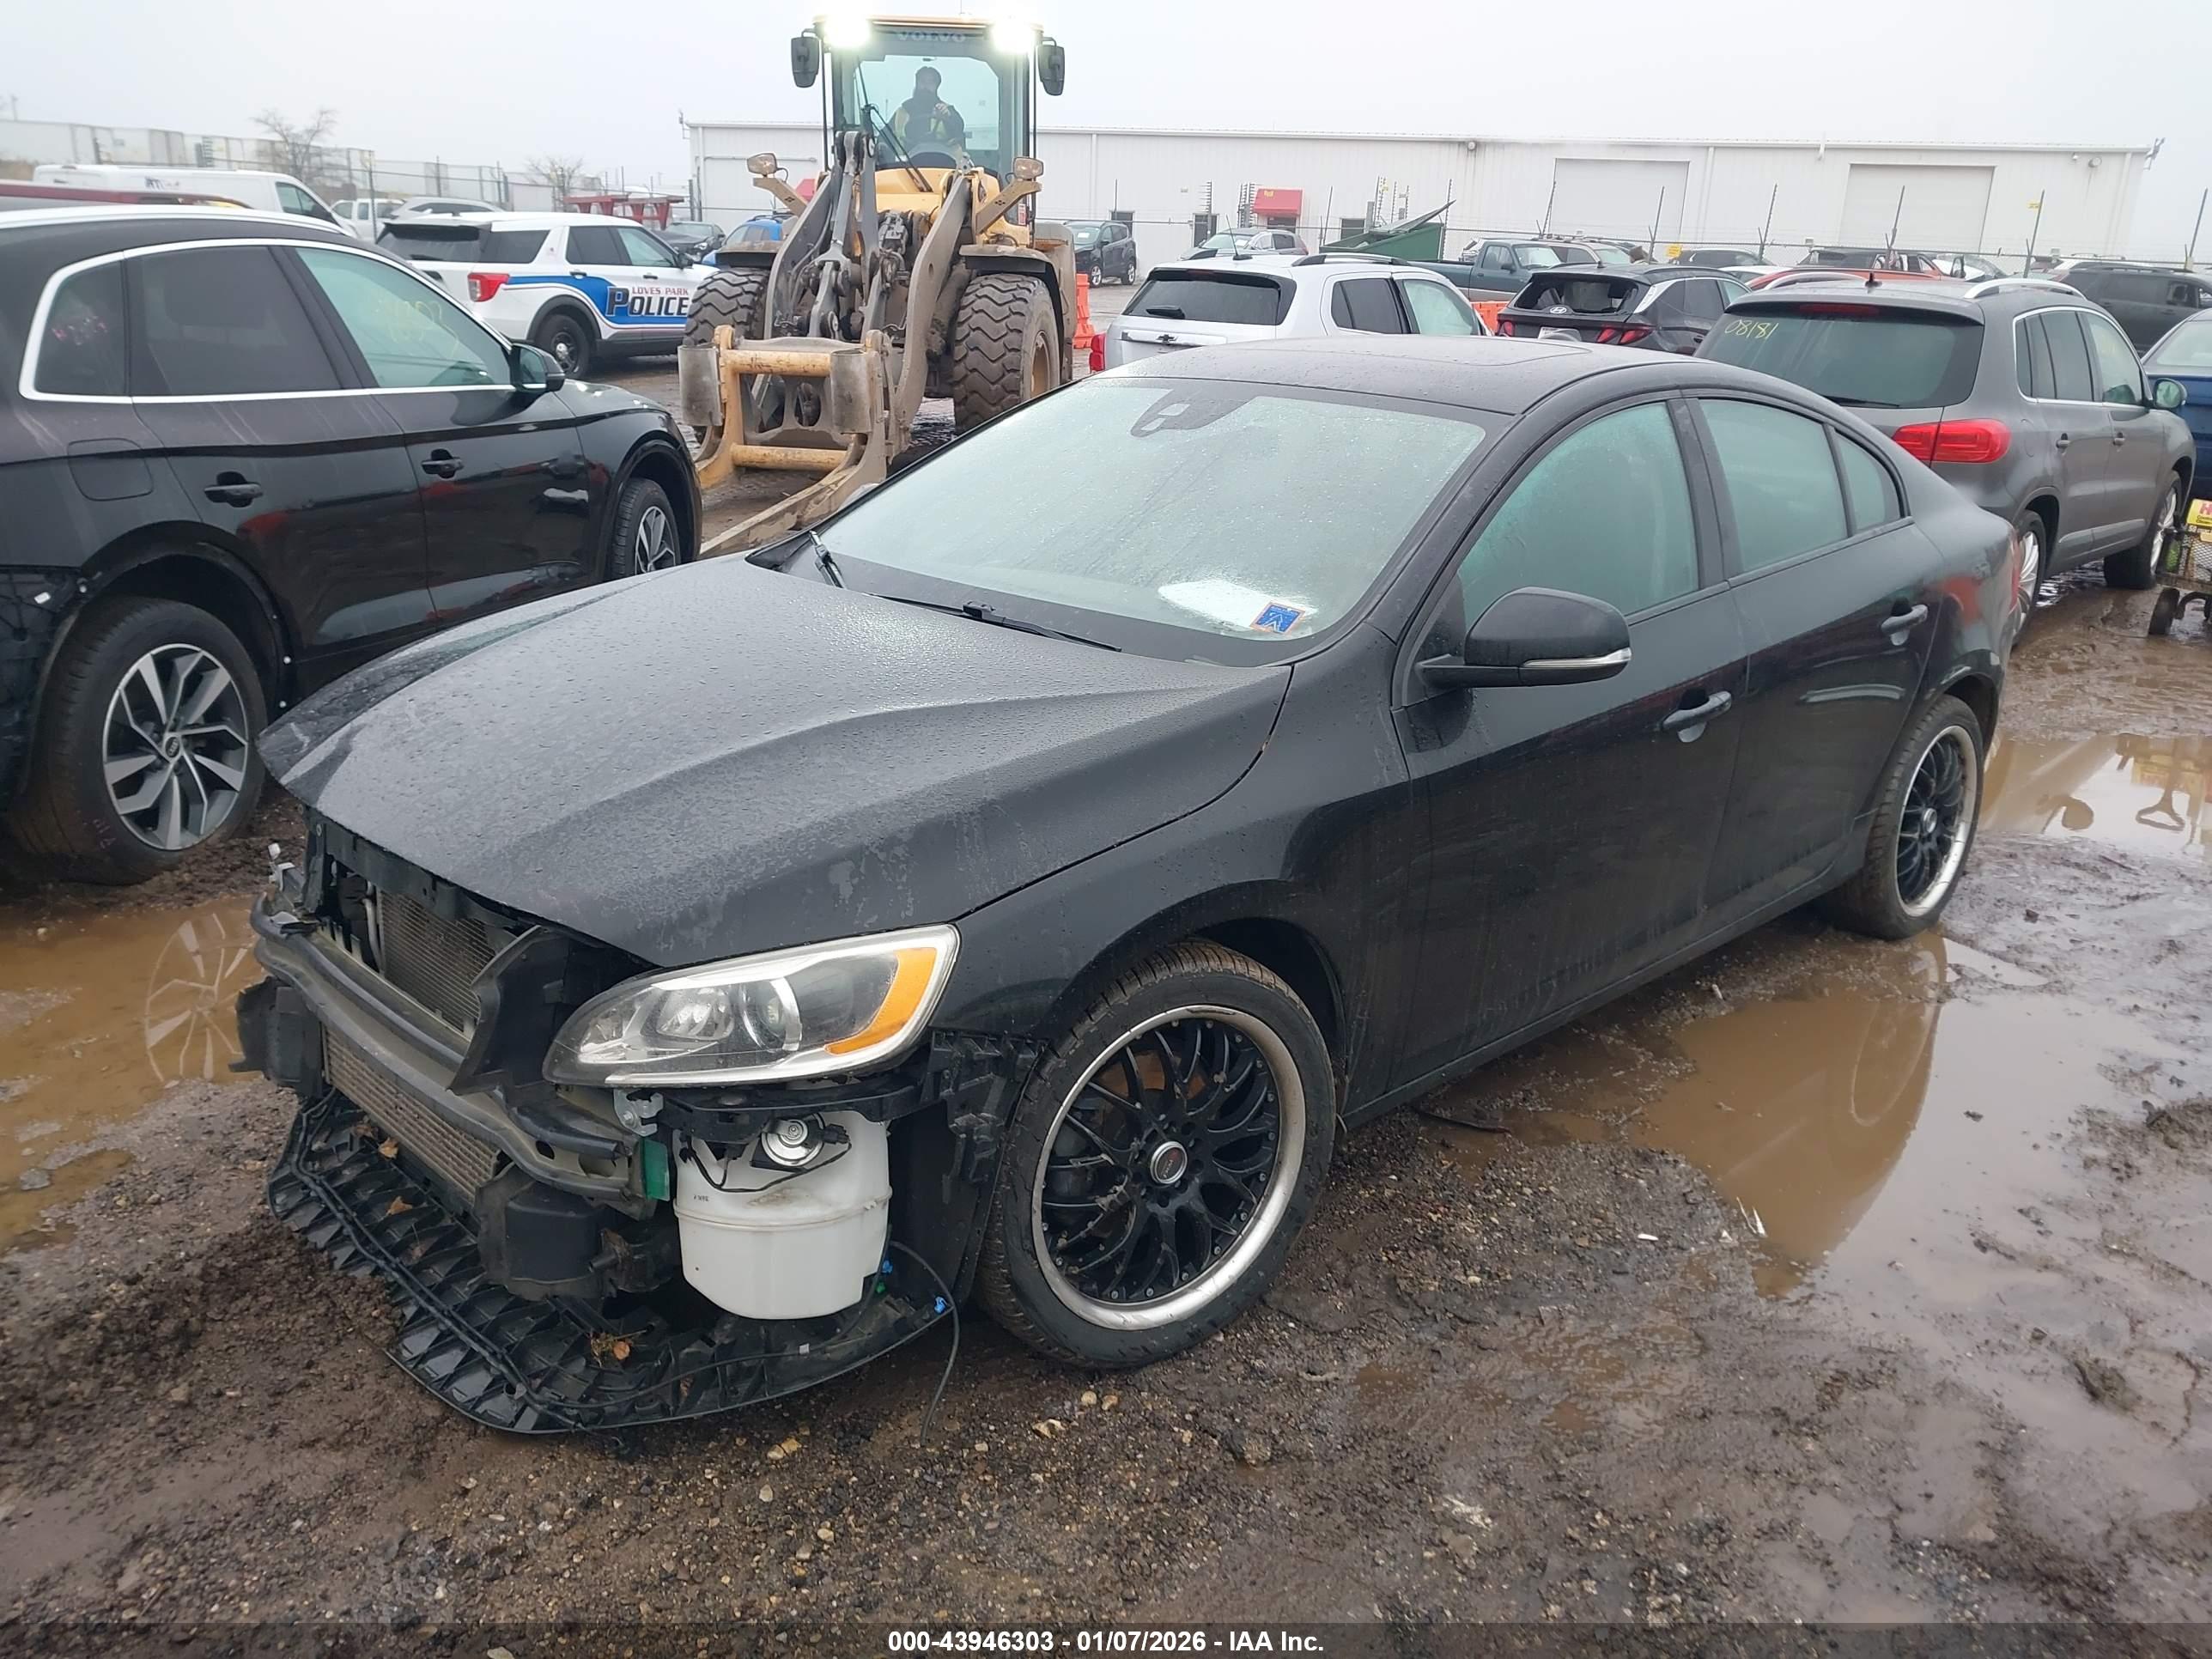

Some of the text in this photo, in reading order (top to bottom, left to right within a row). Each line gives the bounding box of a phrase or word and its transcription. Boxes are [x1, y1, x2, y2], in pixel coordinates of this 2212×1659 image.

[898, 32, 966, 42] VOLVO
[605, 287, 690, 316] POLICE
[1724, 319, 1779, 340] 08181
